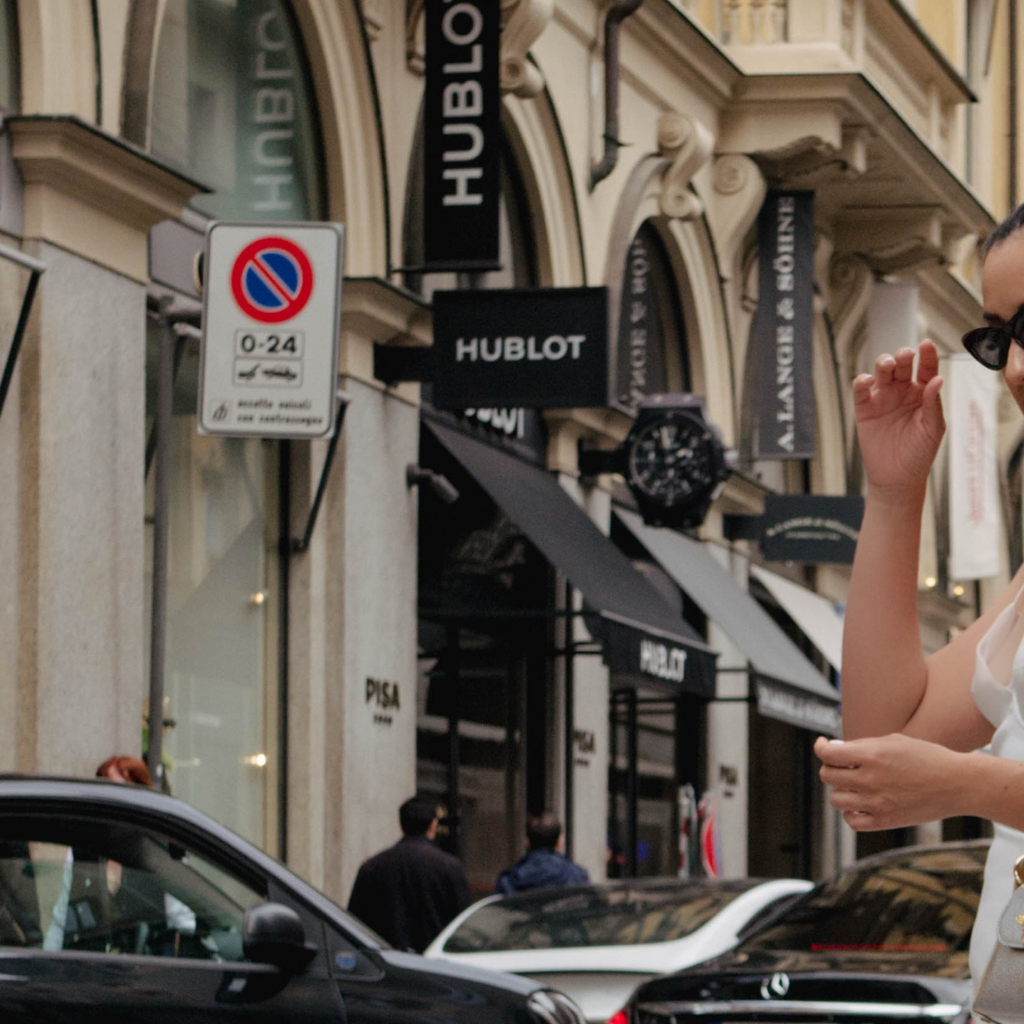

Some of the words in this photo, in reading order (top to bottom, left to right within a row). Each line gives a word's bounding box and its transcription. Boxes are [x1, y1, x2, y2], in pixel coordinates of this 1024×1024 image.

[442, 0, 484, 206] HUBLO
[772, 197, 794, 291] SÖHNE
[776, 298, 794, 321] &
[241, 335, 296, 353] 0-24
[456, 335, 586, 362] HUBLOT
[366, 678, 400, 710] PISA
